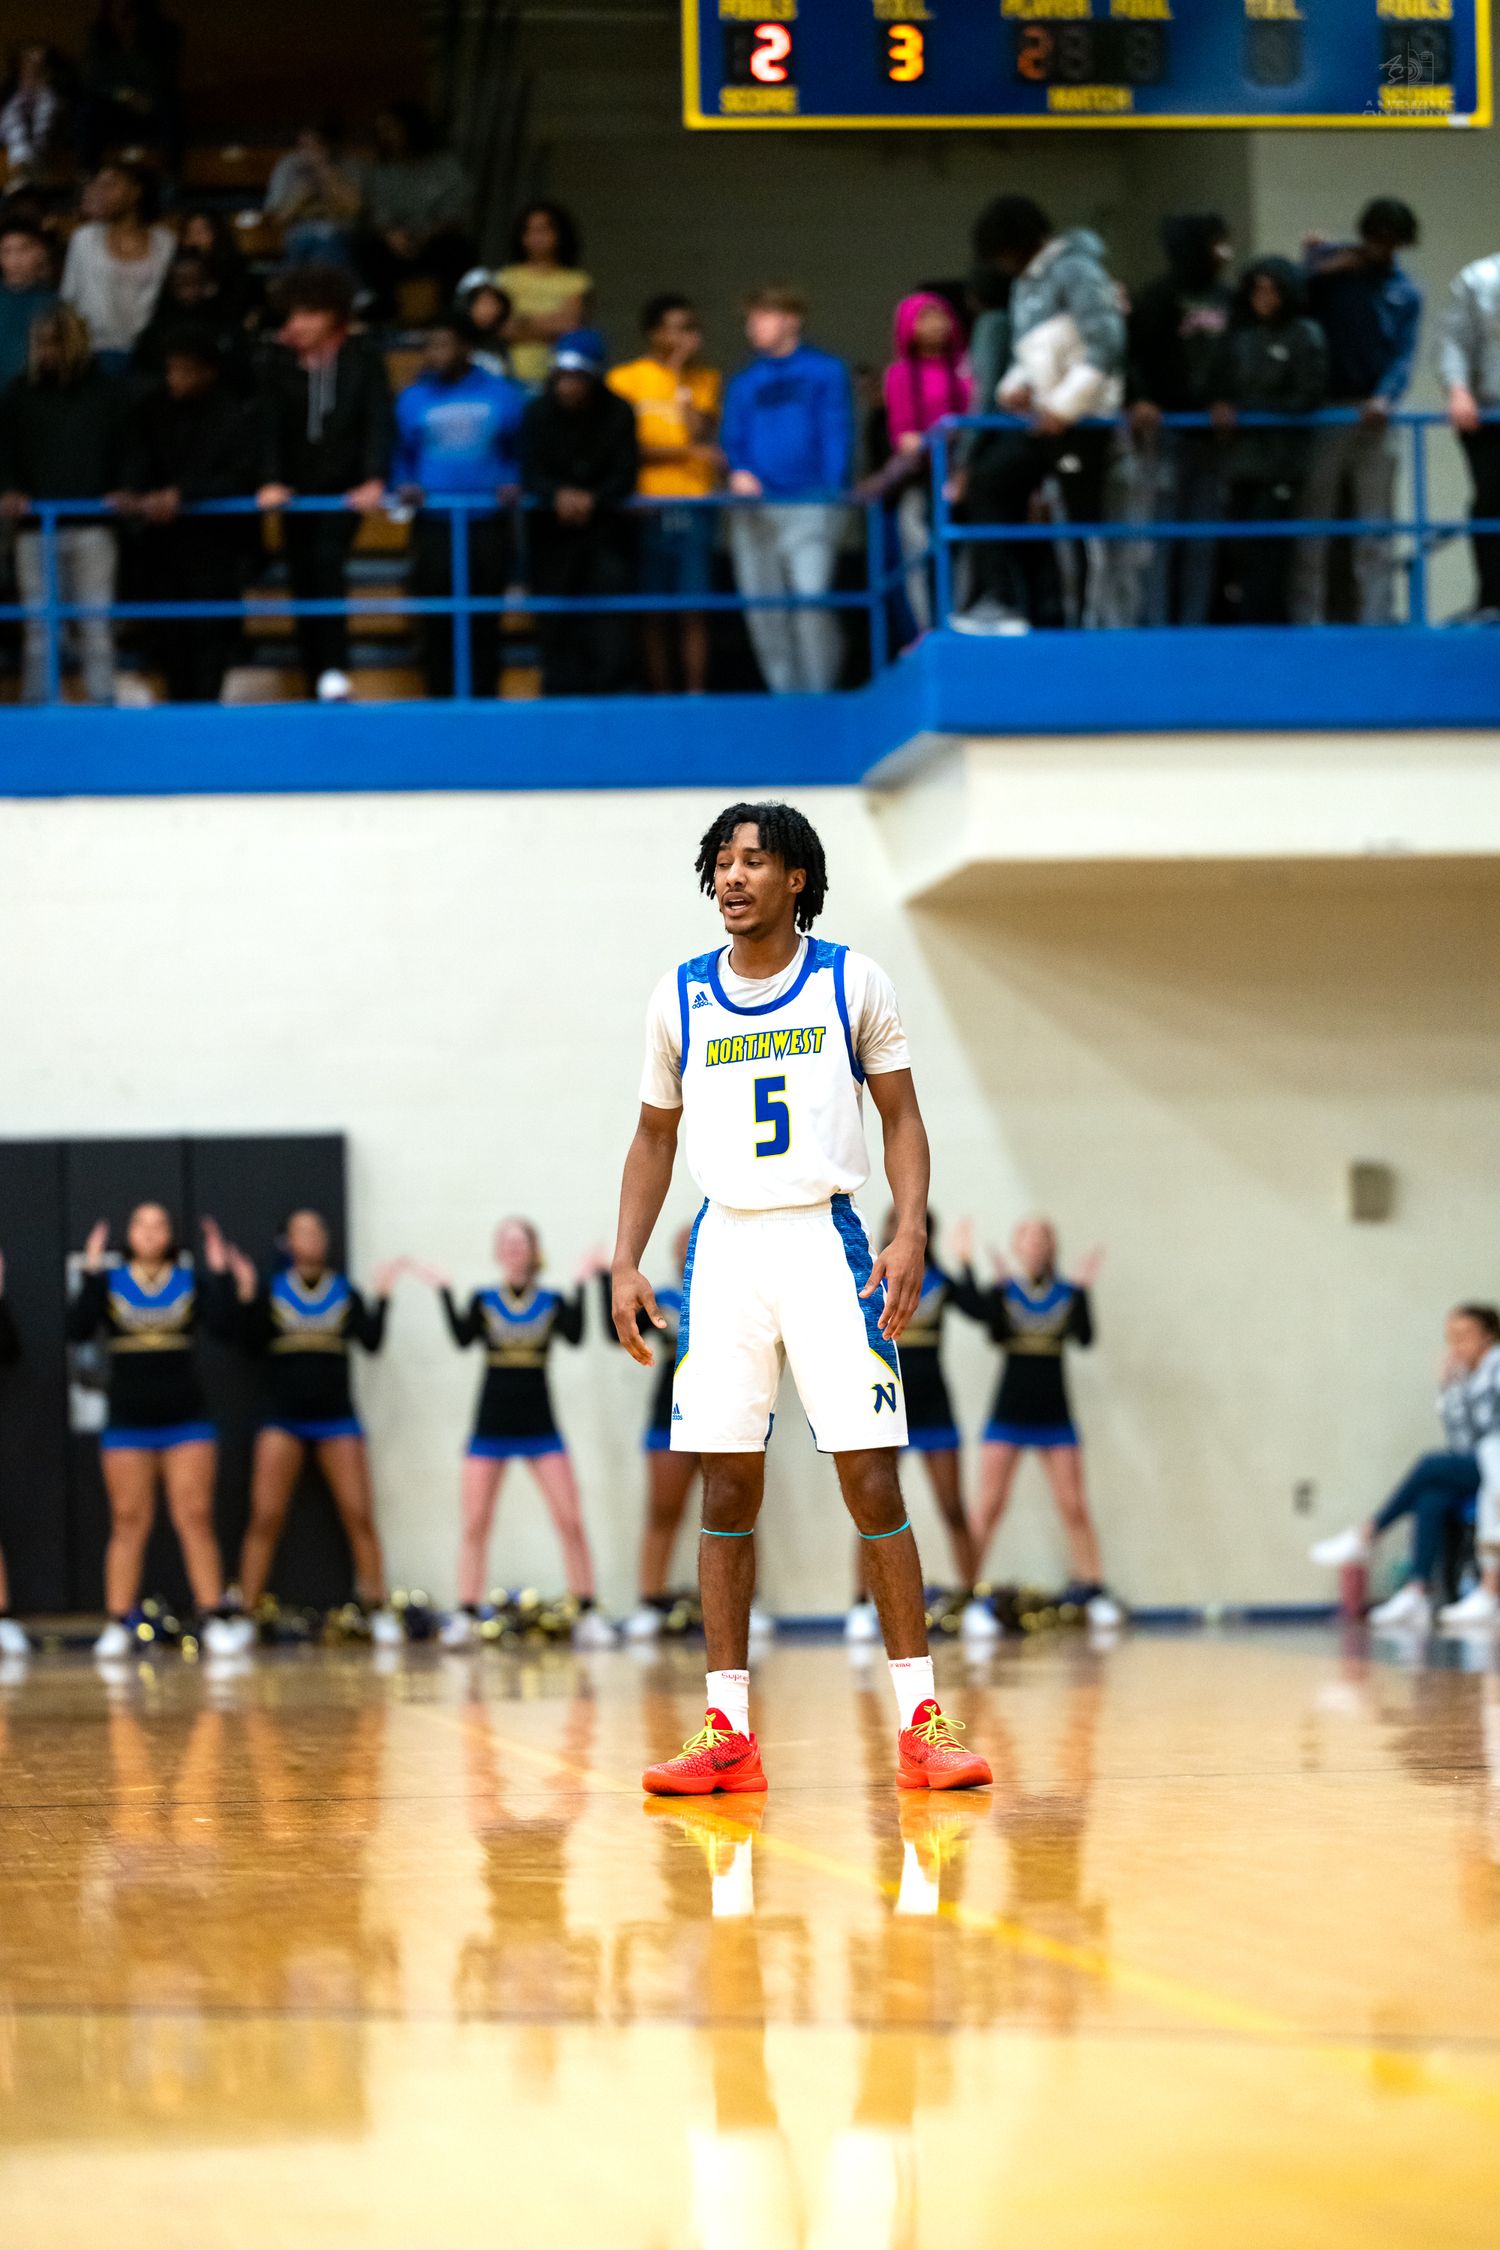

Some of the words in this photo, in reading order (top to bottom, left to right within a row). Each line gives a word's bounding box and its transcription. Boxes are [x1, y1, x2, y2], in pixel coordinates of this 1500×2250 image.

[750, 23, 792, 82] 2
[888, 24, 924, 82] 3
[706, 1026, 826, 1067] NORTHWEST
[753, 1074, 791, 1159] 5
[870, 1382, 898, 1414] N
